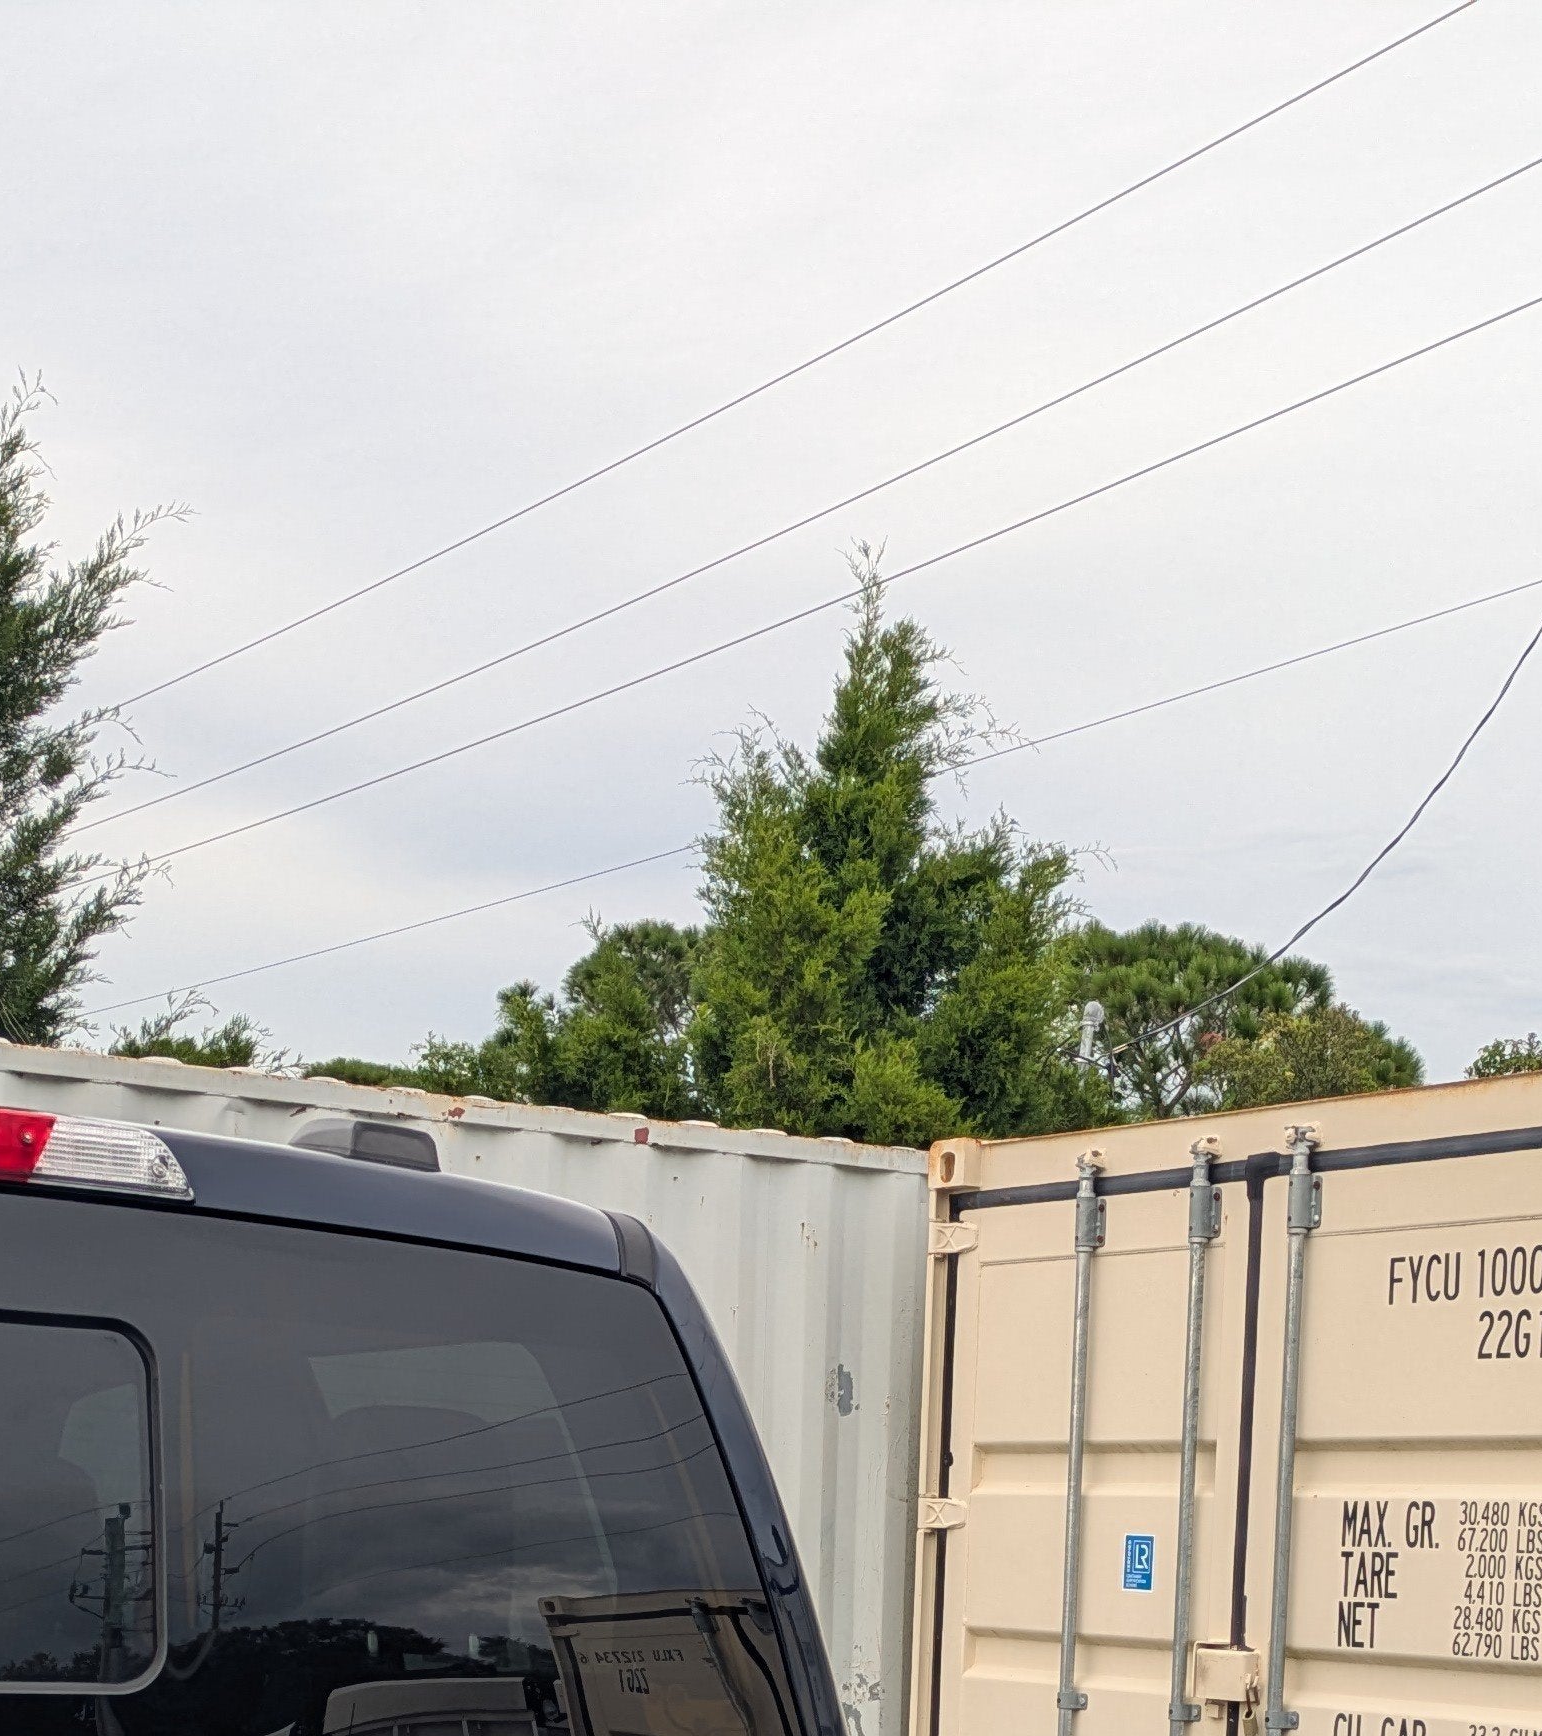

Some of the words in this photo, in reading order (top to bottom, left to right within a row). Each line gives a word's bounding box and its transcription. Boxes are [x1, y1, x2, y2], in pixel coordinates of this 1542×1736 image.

[1388, 1251, 1461, 1306] FYCU
[1341, 1500, 1392, 1548] MAX.
[1405, 1500, 1440, 1549] GR.
[1340, 1550, 1399, 1599] TARE
[1512, 1582, 1542, 1608] LBS
[1337, 1600, 1380, 1649] NET
[1511, 1608, 1542, 1635] KGS
[1510, 1635, 1540, 1662] LBS
